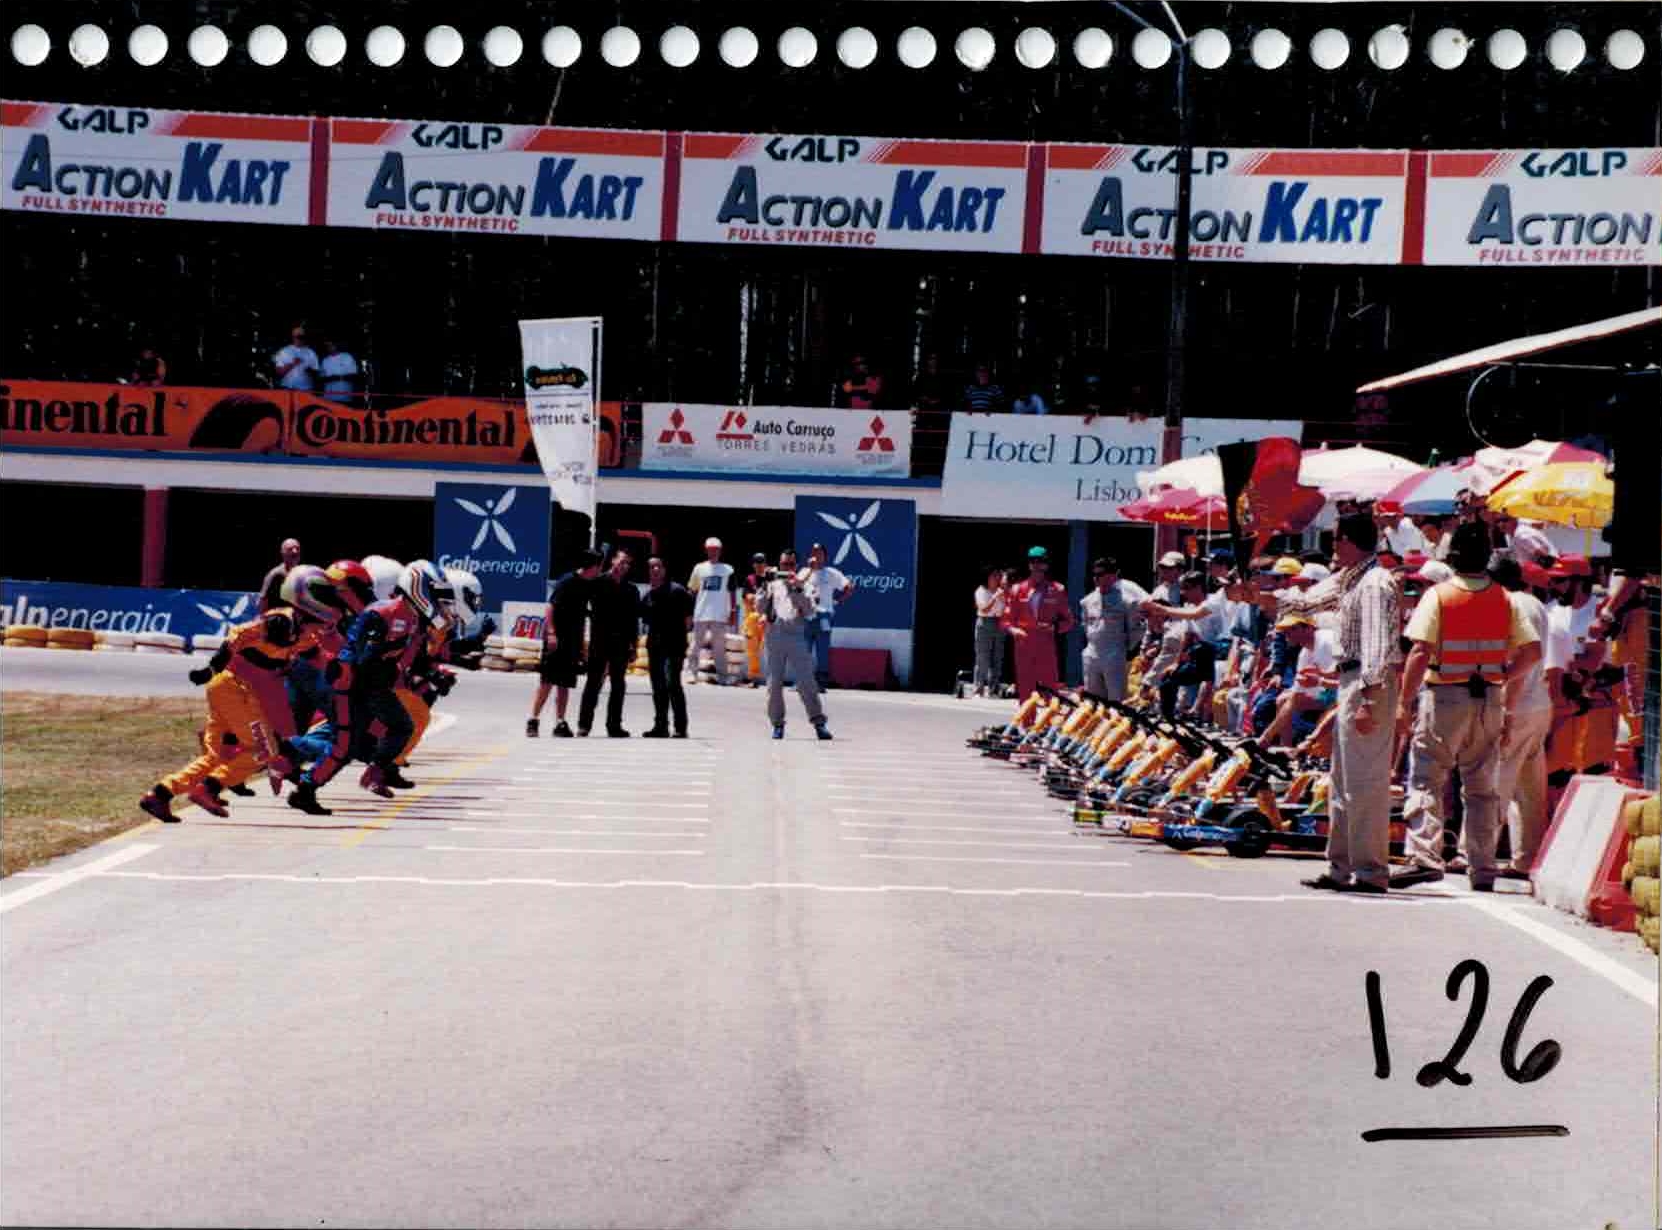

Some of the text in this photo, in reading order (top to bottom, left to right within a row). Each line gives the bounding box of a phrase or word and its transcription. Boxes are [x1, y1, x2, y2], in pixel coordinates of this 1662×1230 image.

[57, 107, 149, 134] GALP
[411, 124, 503, 150] GALP
[765, 137, 860, 163] GALP
[12, 133, 291, 206] ACTION KART
[1520, 152, 1627, 177] GALP
[366, 151, 643, 221] ACTION KART
[21, 195, 167, 216] FULL SYNTHETIC
[717, 165, 1005, 234] ACTION KART
[1081, 176, 1383, 244] ACTON KART
[376, 212, 519, 232] FULL SYNTHETIC
[1466, 183, 1652, 245] ACTION
[727, 227, 876, 245] FULL SYNTHETIC
[1091, 240, 1244, 258] FULL SYNHETIC
[1480, 249, 1645, 262] FULL SYNTHETIC
[296, 405, 516, 448] Continental
[753, 419, 782, 434] Auto
[964, 430, 1056, 464] Hotel
[1069, 434, 1157, 466] Dom
[845, 571, 906, 593] nergia
[1366, 959, 1562, 1087] 126
